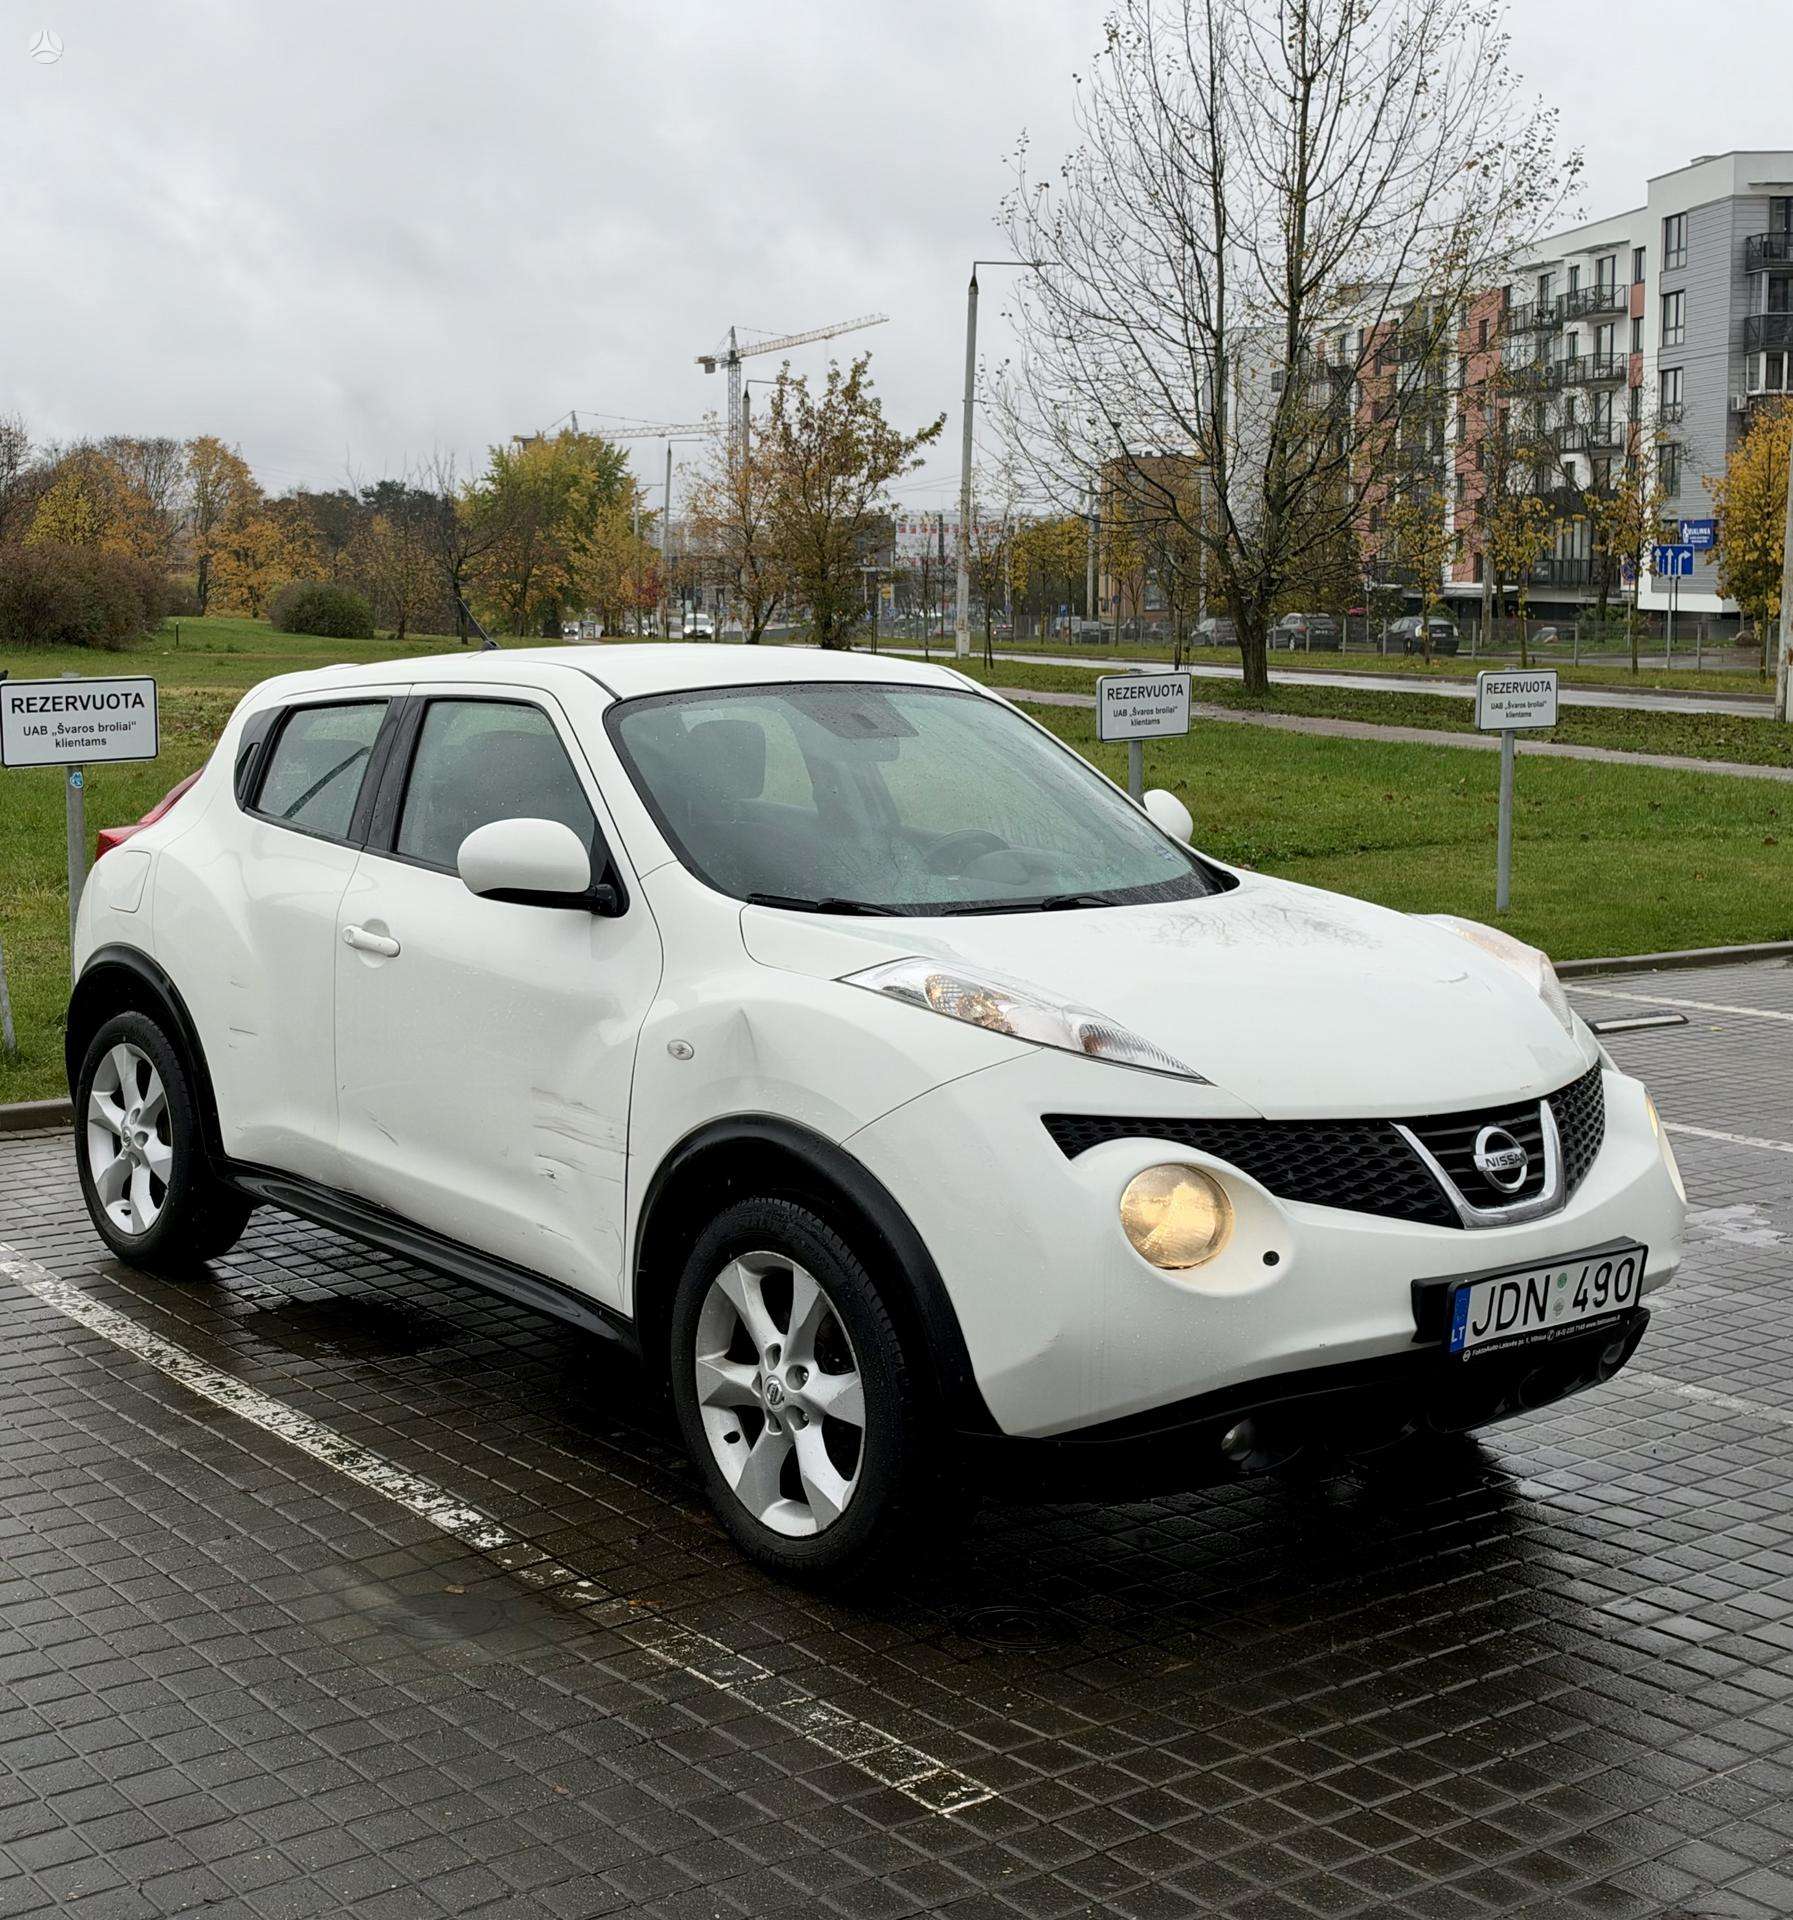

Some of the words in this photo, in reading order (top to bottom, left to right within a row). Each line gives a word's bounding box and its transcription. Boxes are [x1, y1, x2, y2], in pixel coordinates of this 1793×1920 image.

[1107, 684, 1184, 700] REZERVUOTA
[1486, 681, 1552, 694] REZERVUOTA
[11, 692, 146, 714] REZERVUOTA
[1490, 702, 1503, 710] UAB
[1113, 709, 1128, 717] UAB
[1130, 718, 1160, 726] klientams
[23, 725, 48, 736] UAB
[55, 737, 107, 748] klientams
[1472, 1274, 1550, 1336] JDN
[1572, 1257, 1636, 1312] 490
[1451, 1326, 1466, 1342] LT
